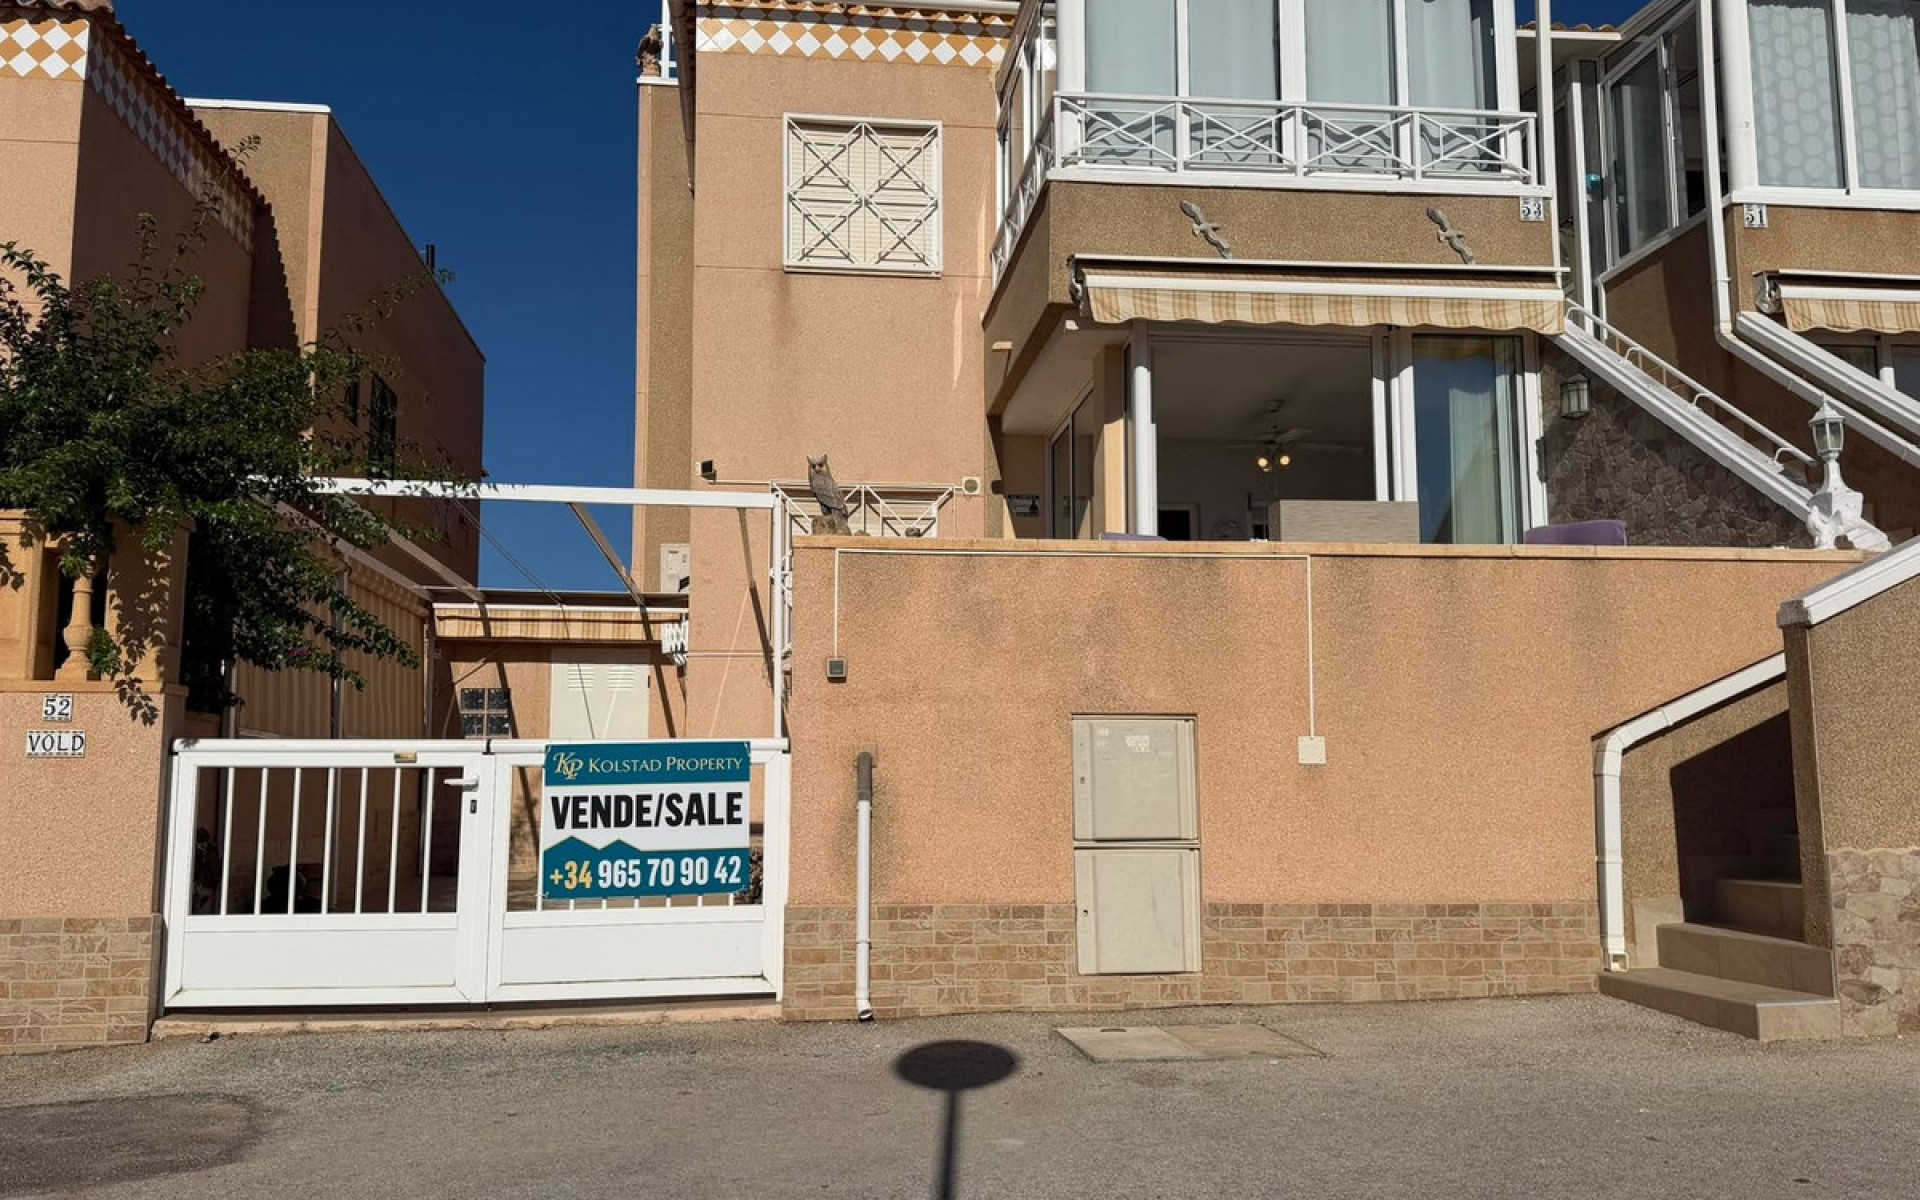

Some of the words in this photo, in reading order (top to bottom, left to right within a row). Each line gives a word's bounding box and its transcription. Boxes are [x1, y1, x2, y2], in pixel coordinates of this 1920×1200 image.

[1521, 201, 1542, 217] 53
[1746, 209, 1764, 224] 51
[44, 698, 70, 716] 52
[28, 734, 84, 752] VOLD
[588, 757, 662, 773] KOLSTAD
[666, 755, 743, 772] PROPERTY
[550, 791, 743, 830] VENDE/SALE
[550, 860, 593, 890] +34
[598, 858, 641, 888] 965
[647, 857, 675, 887] 70
[680, 856, 708, 886] 90
[713, 855, 742, 884] 42
